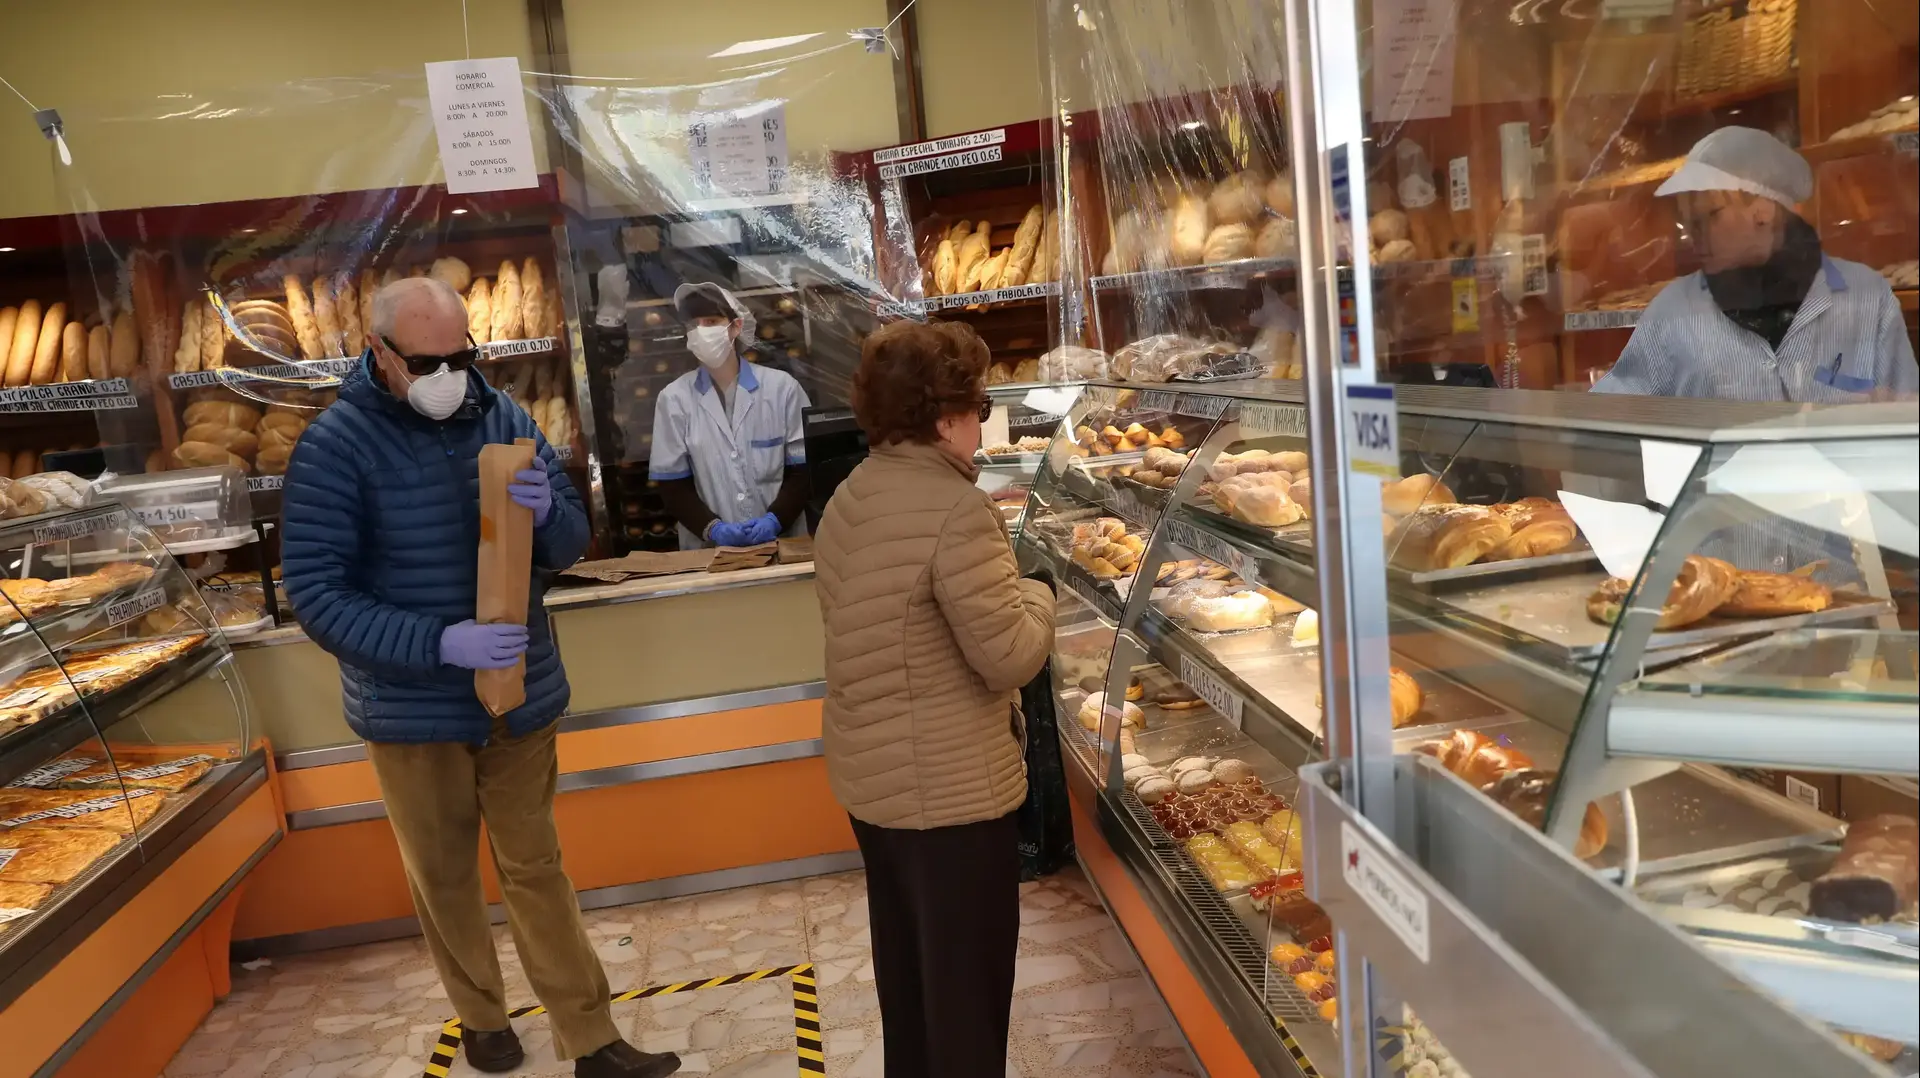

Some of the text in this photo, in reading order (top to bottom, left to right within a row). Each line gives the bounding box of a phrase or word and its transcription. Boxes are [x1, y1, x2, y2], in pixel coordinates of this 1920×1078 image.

[455, 72, 487, 81] HORARIO
[455, 82, 495, 91] COMERCIAL
[448, 102, 471, 111] LUNES
[477, 100, 506, 109] VIERNES
[446, 113, 466, 121] 8:00h
[485, 110, 508, 118] 20:00h
[462, 129, 494, 139] SÁBADOS
[452, 141, 471, 149] 8:00h
[489, 138, 511, 146] 15:00h
[875, 132, 991, 161] BARRA ESPECIAL TORRIJAS 2.50
[469, 157, 508, 167] DOMINGOS
[908, 158, 941, 174] GRANDE
[941, 156, 960, 169] 1.00
[980, 148, 1001, 162] 0.65
[494, 166, 516, 174] 14:30h
[997, 287, 1034, 300] FABIOLA
[945, 296, 970, 307] PICOS
[490, 342, 528, 357] RUSTICA
[530, 339, 551, 351] 0.70
[19, 387, 54, 401] PULGA
[57, 382, 98, 398] GRANDE
[102, 379, 127, 393] 0.25
[1352, 410, 1392, 451] VISA
